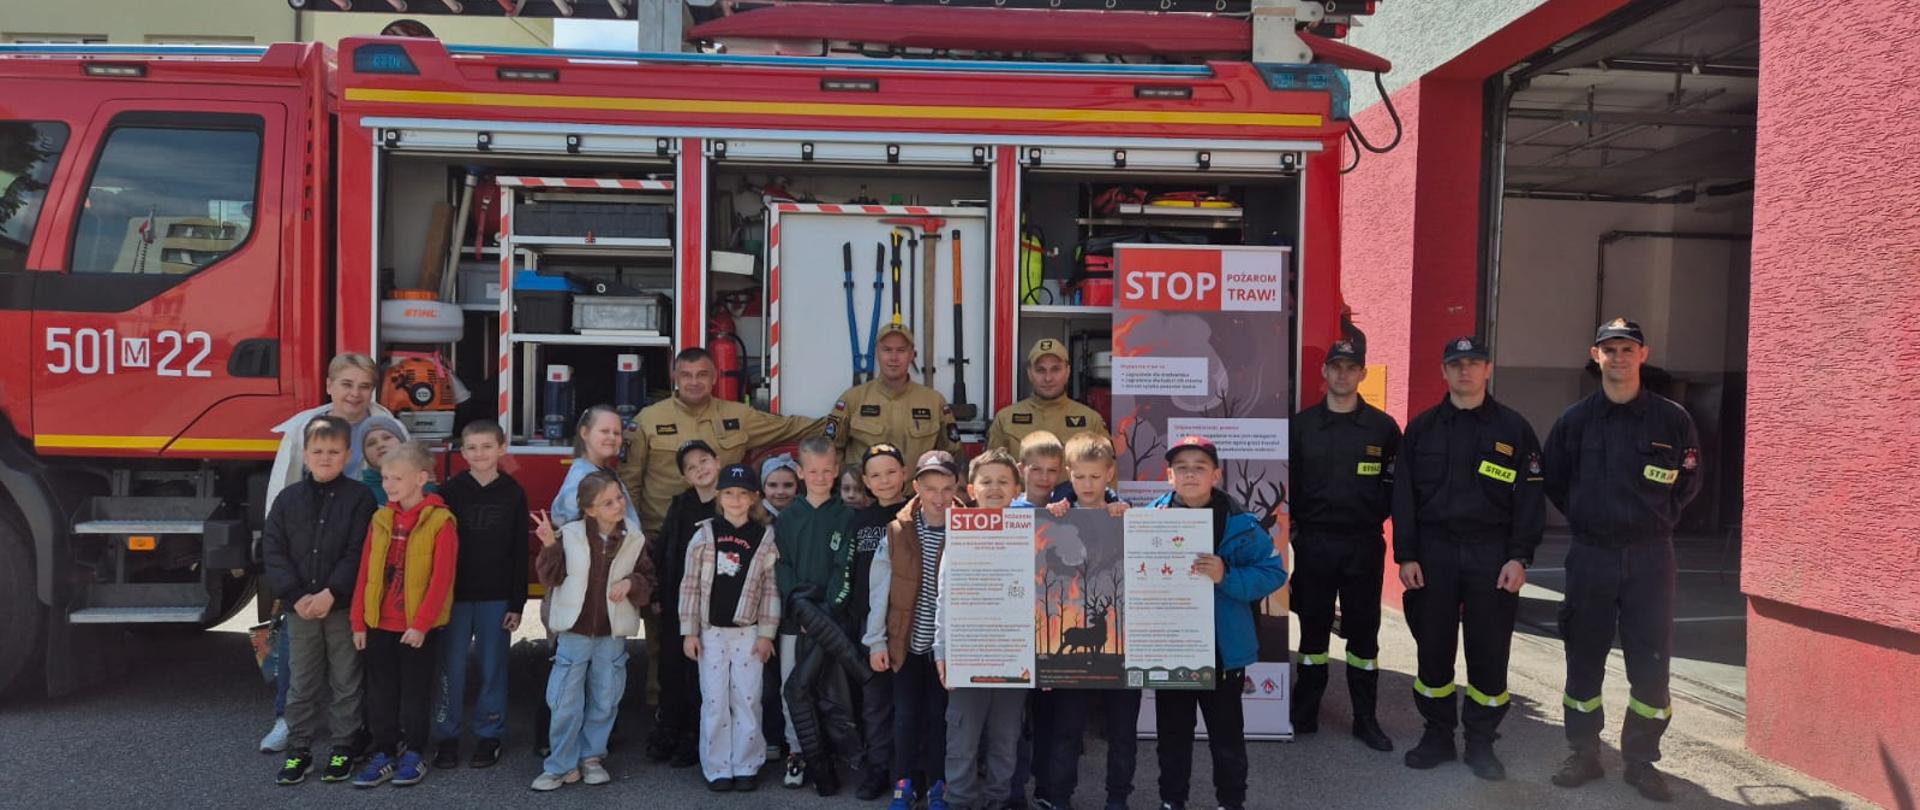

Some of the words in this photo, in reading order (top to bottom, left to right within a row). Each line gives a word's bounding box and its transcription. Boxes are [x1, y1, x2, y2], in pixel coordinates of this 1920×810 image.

[1125, 271, 1216, 301] STOP
[1226, 272, 1277, 283] POŻAROM
[1227, 288, 1276, 301] TRAW!
[46, 327, 115, 375] 501
[124, 340, 147, 365] M
[157, 329, 212, 377] 22
[951, 513, 1001, 530] STOP
